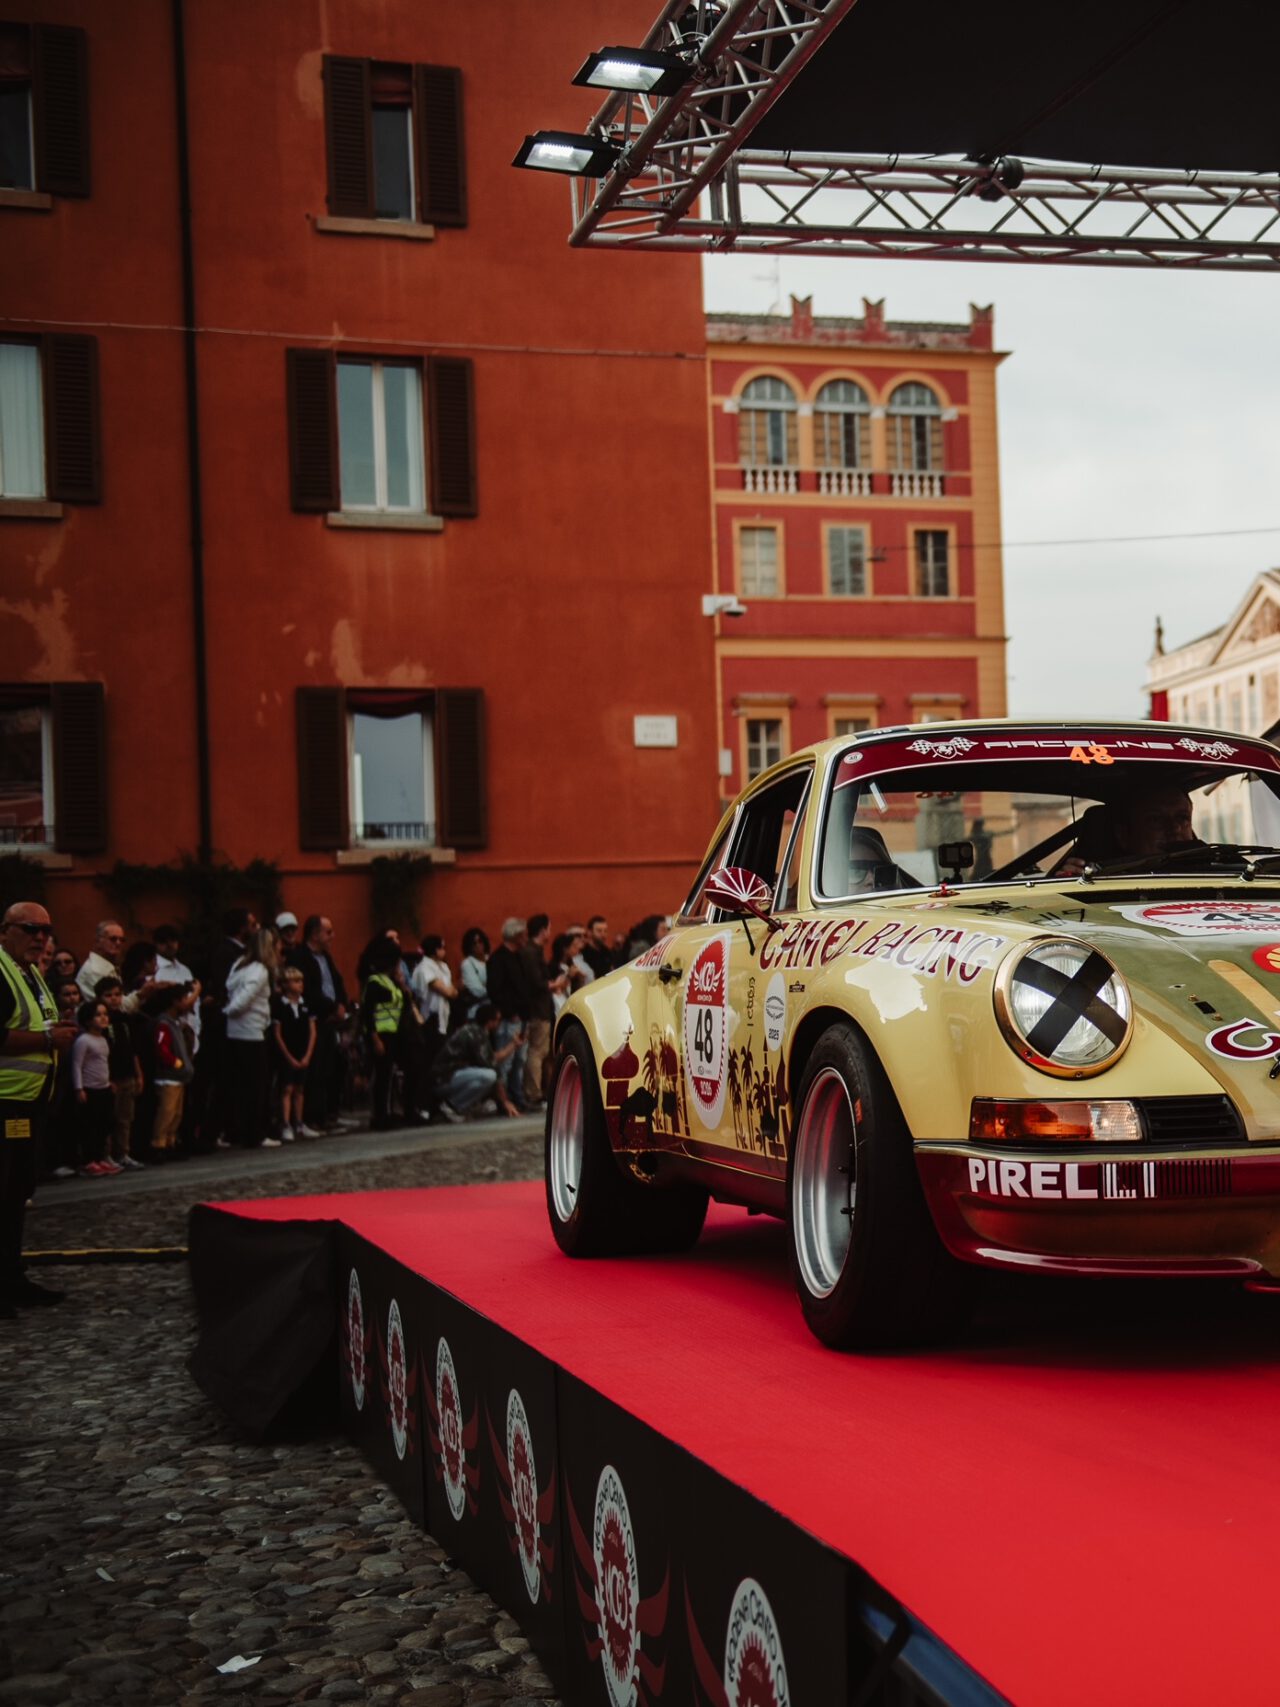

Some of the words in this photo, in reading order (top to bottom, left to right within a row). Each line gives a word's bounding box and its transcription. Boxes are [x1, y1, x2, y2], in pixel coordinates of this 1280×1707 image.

[1069, 745, 1115, 764] 48
[759, 918, 869, 970] CAMEL
[852, 922, 1004, 982] RACING
[694, 1008, 713, 1064] 48
[968, 1158, 1155, 1199] PIRELLI
